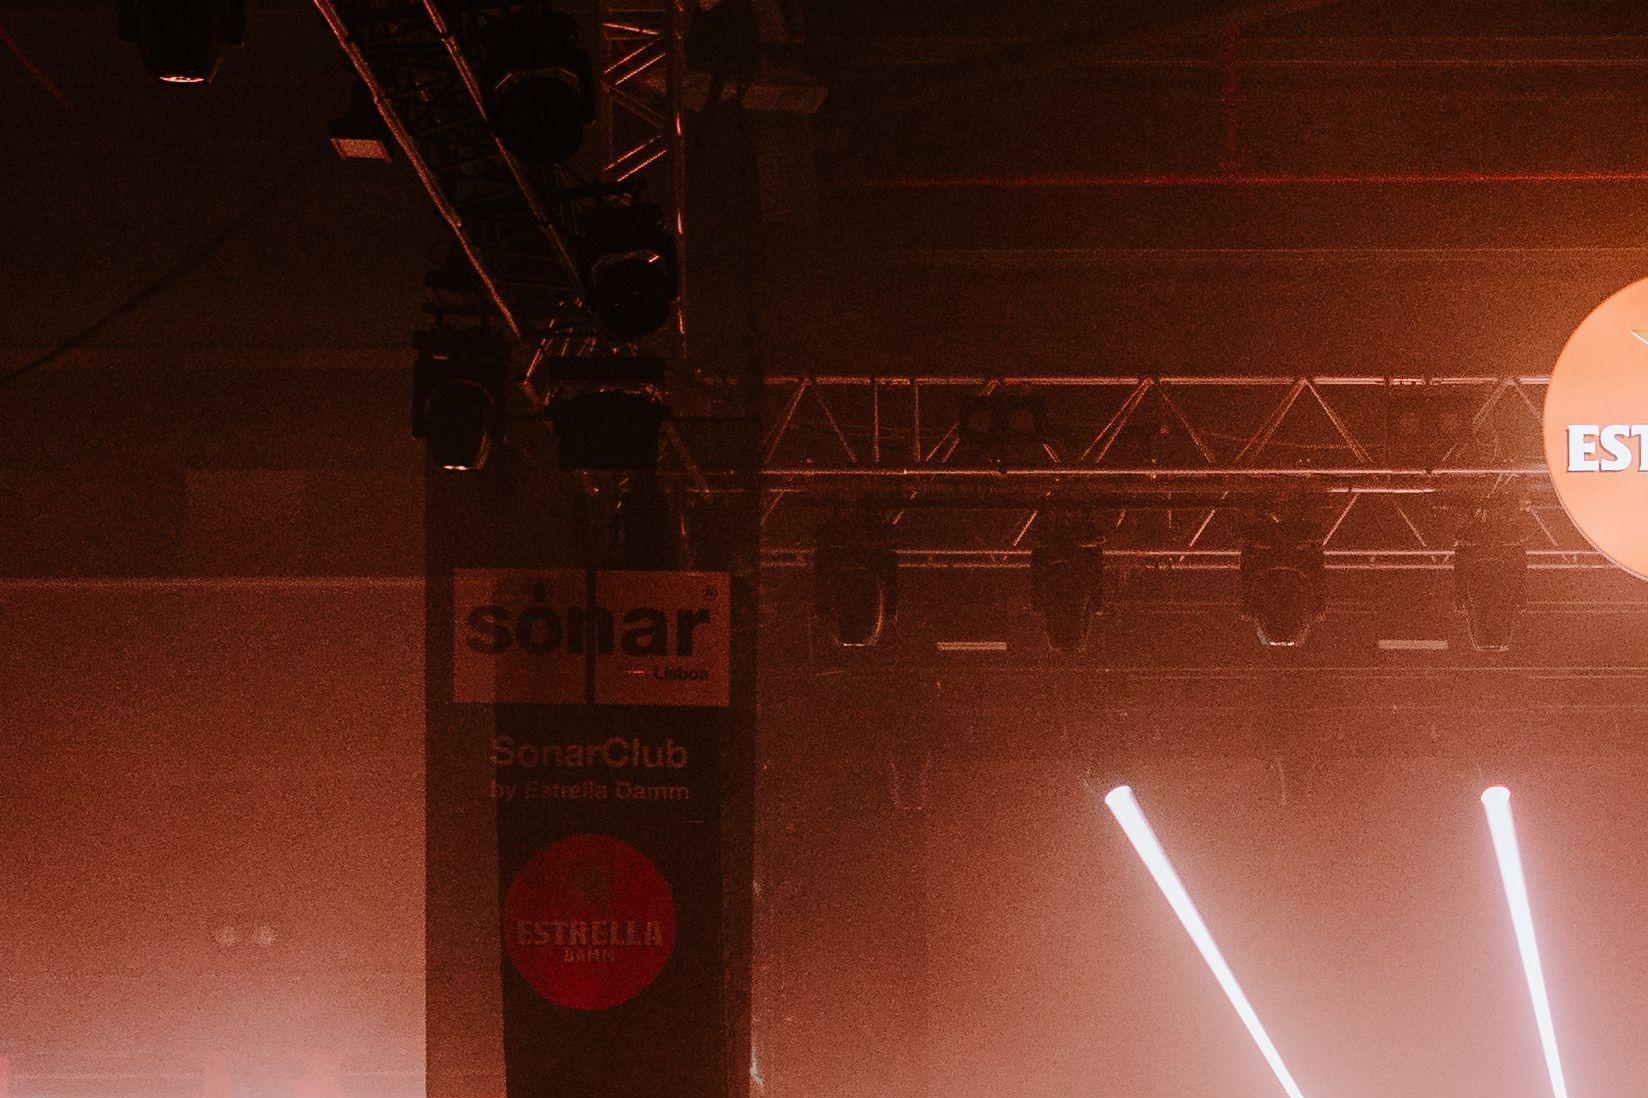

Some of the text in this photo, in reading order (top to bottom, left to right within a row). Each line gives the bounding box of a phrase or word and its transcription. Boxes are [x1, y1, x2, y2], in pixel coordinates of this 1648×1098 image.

[491, 735, 688, 768] SonarClub
[490, 779, 690, 802] by Estrella Damm
[517, 920, 663, 946] ESTRELLA
